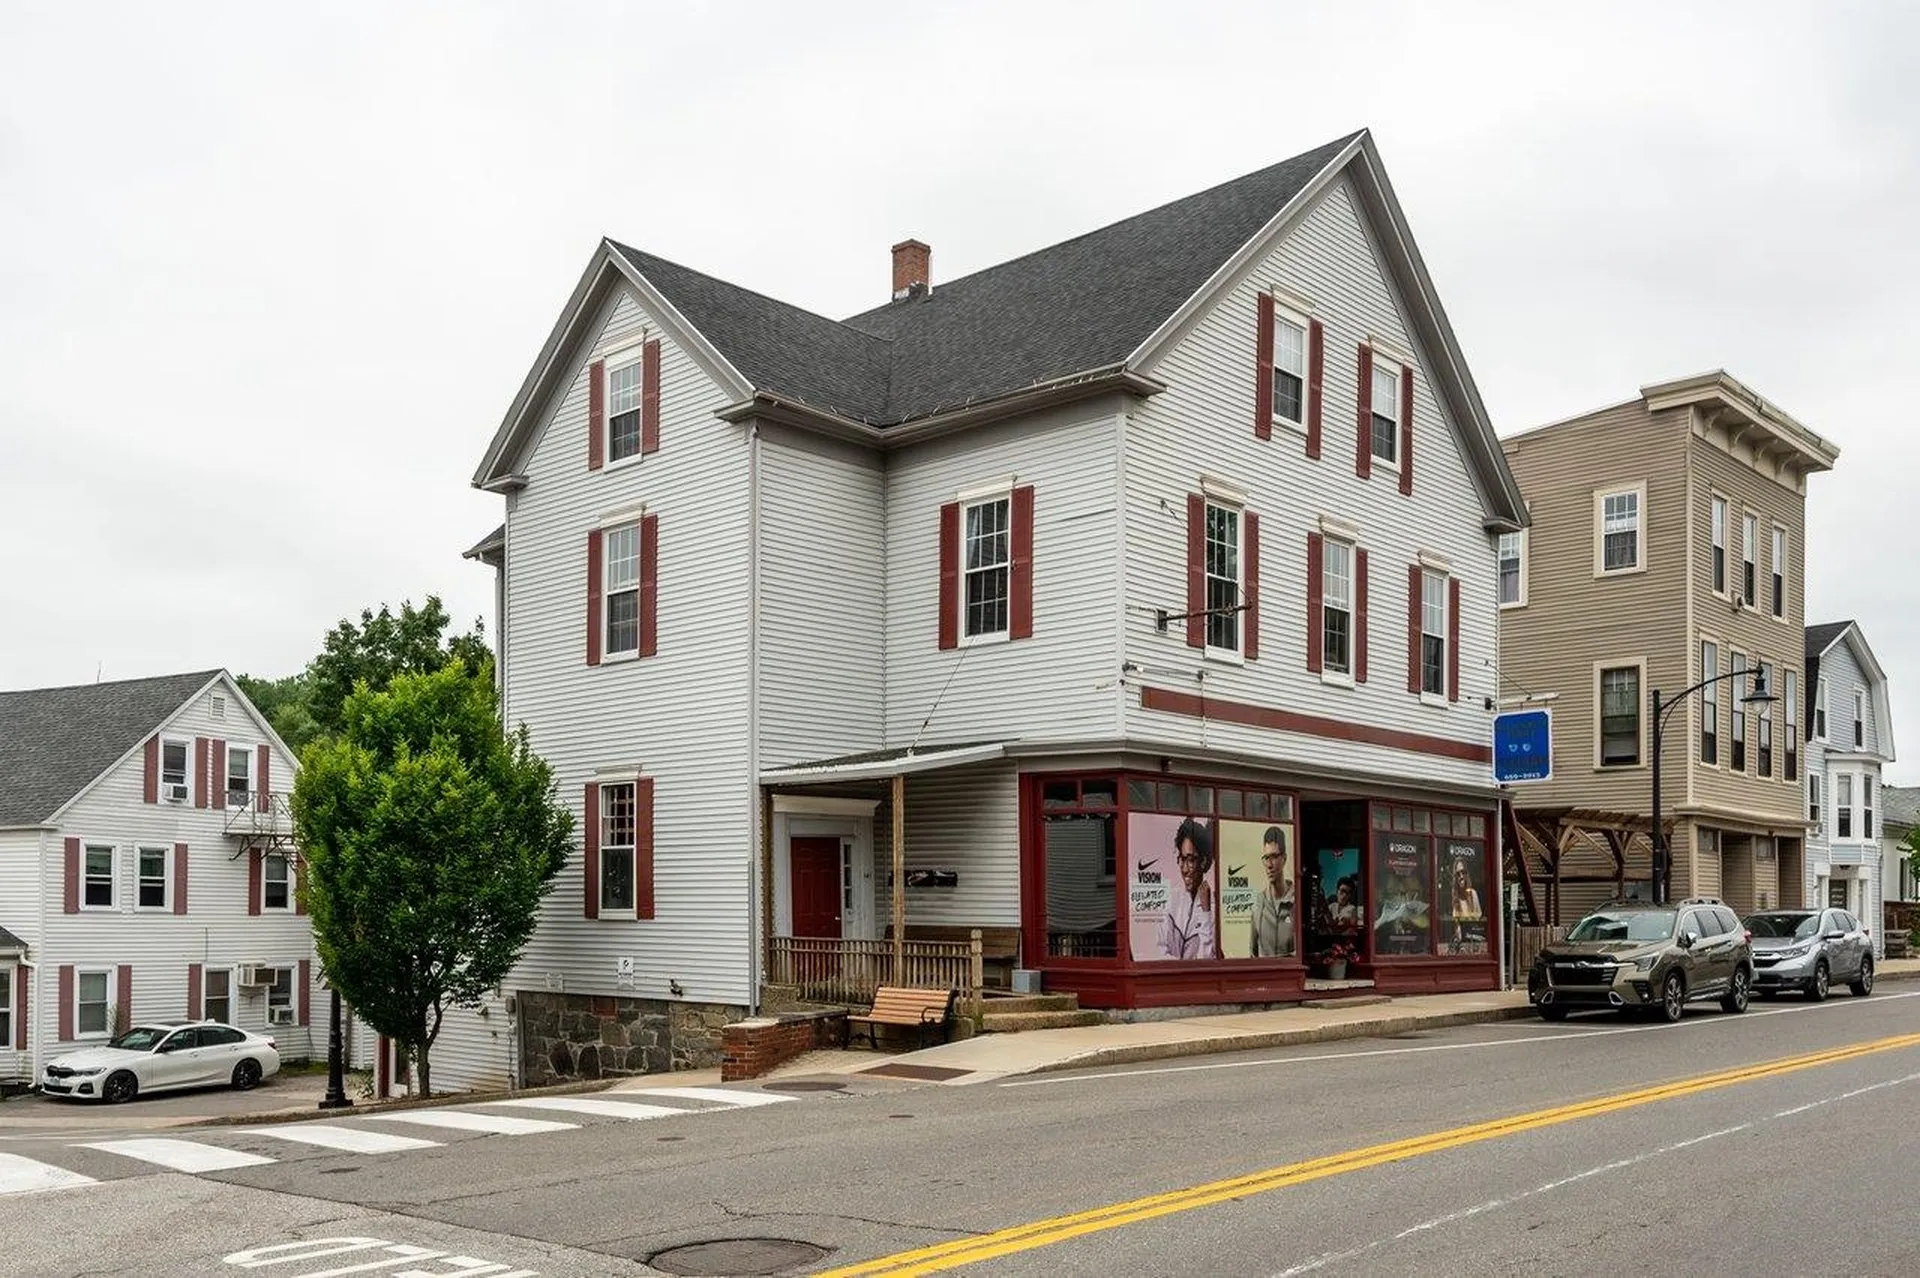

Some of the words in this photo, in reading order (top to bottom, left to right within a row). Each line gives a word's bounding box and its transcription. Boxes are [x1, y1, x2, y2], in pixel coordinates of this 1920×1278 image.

[1137, 871, 1161, 884] VISION
[1228, 876, 1249, 888] VISION
[1135, 900, 1168, 912] COMFORT
